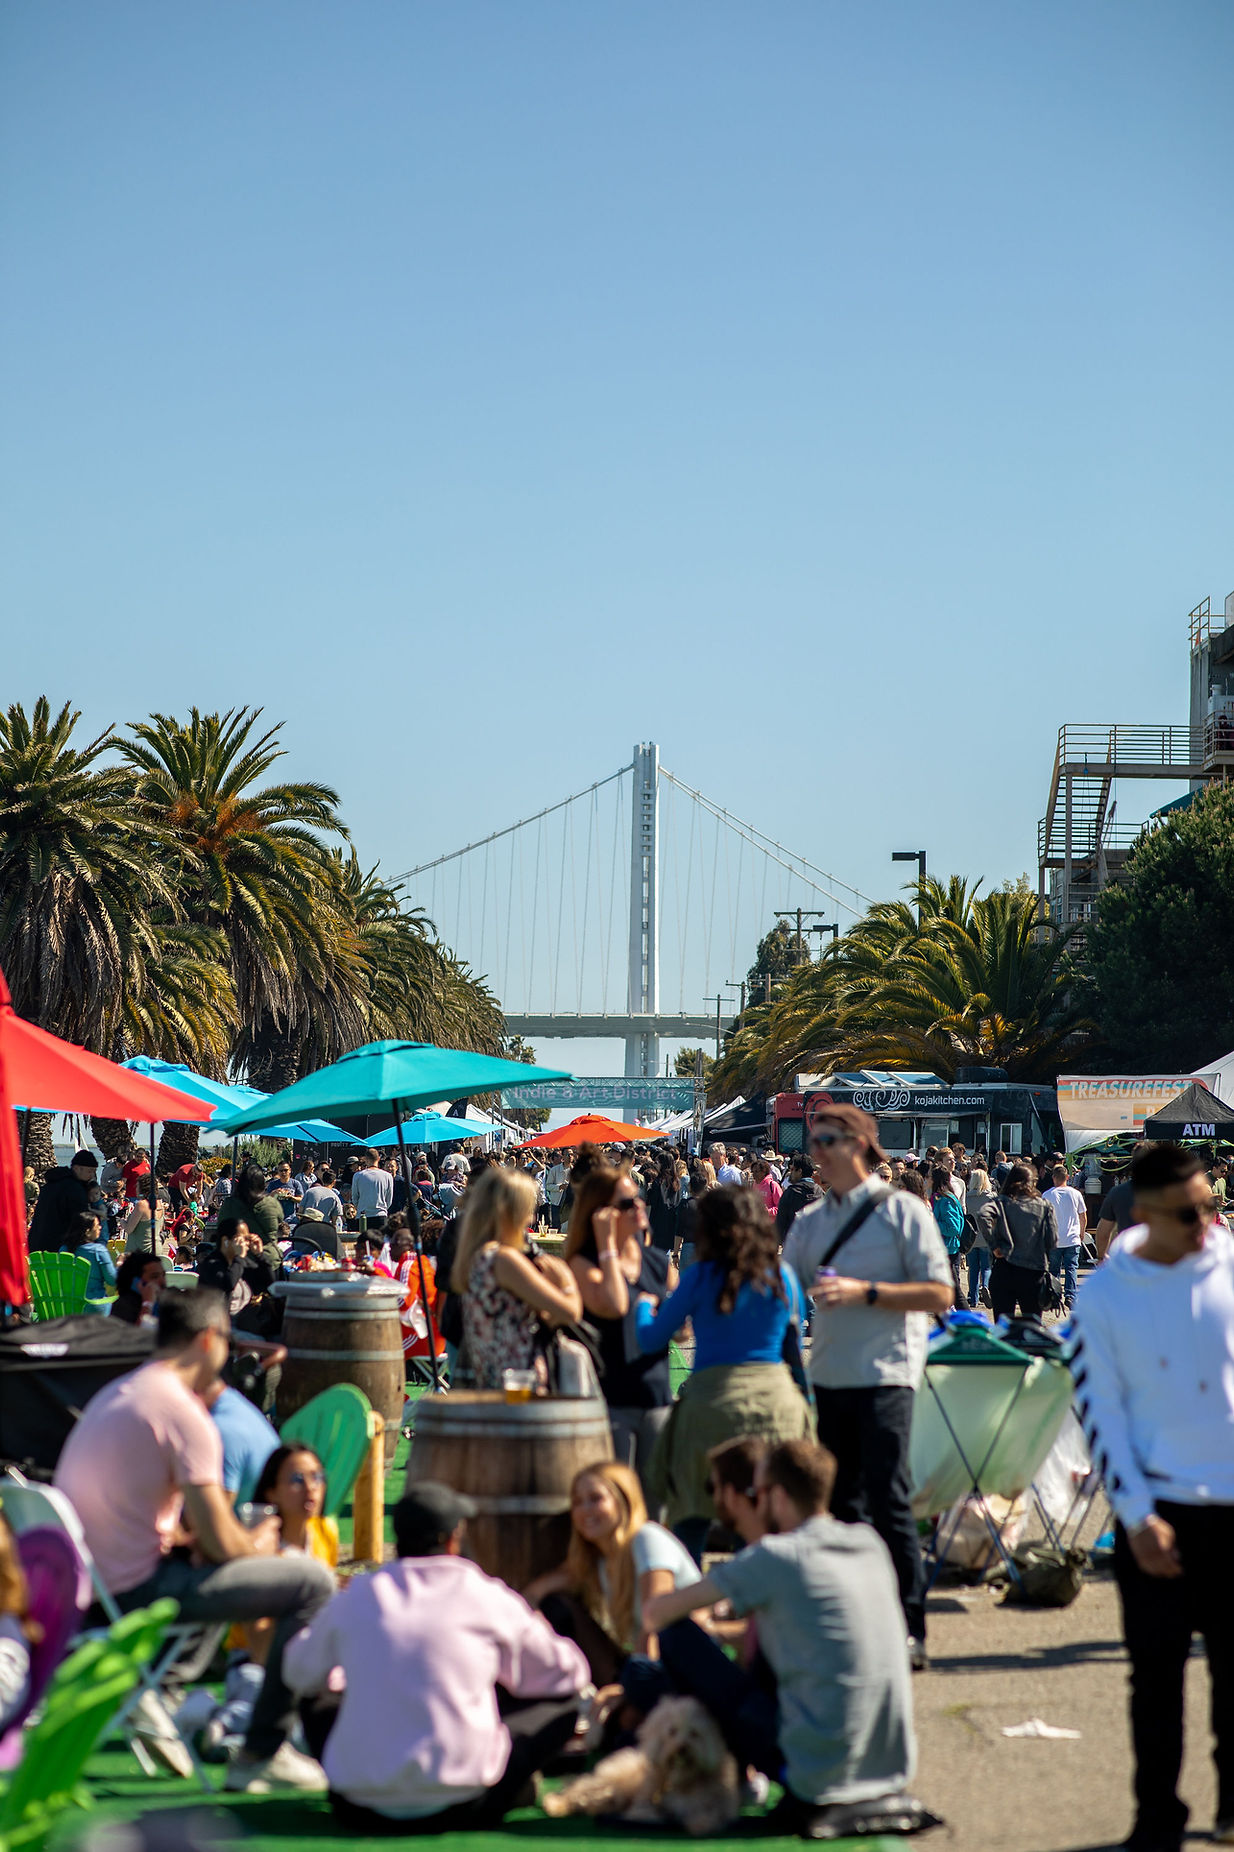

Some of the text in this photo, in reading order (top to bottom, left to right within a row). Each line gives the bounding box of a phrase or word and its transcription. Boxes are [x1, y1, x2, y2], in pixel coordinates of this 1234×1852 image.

[514, 1085, 677, 1099] Indie & Art District
[1070, 1079, 1192, 1099] TREASUREFEST
[914, 1095, 985, 1107] kojakitchen.com
[1182, 1123, 1216, 1136] ATM
